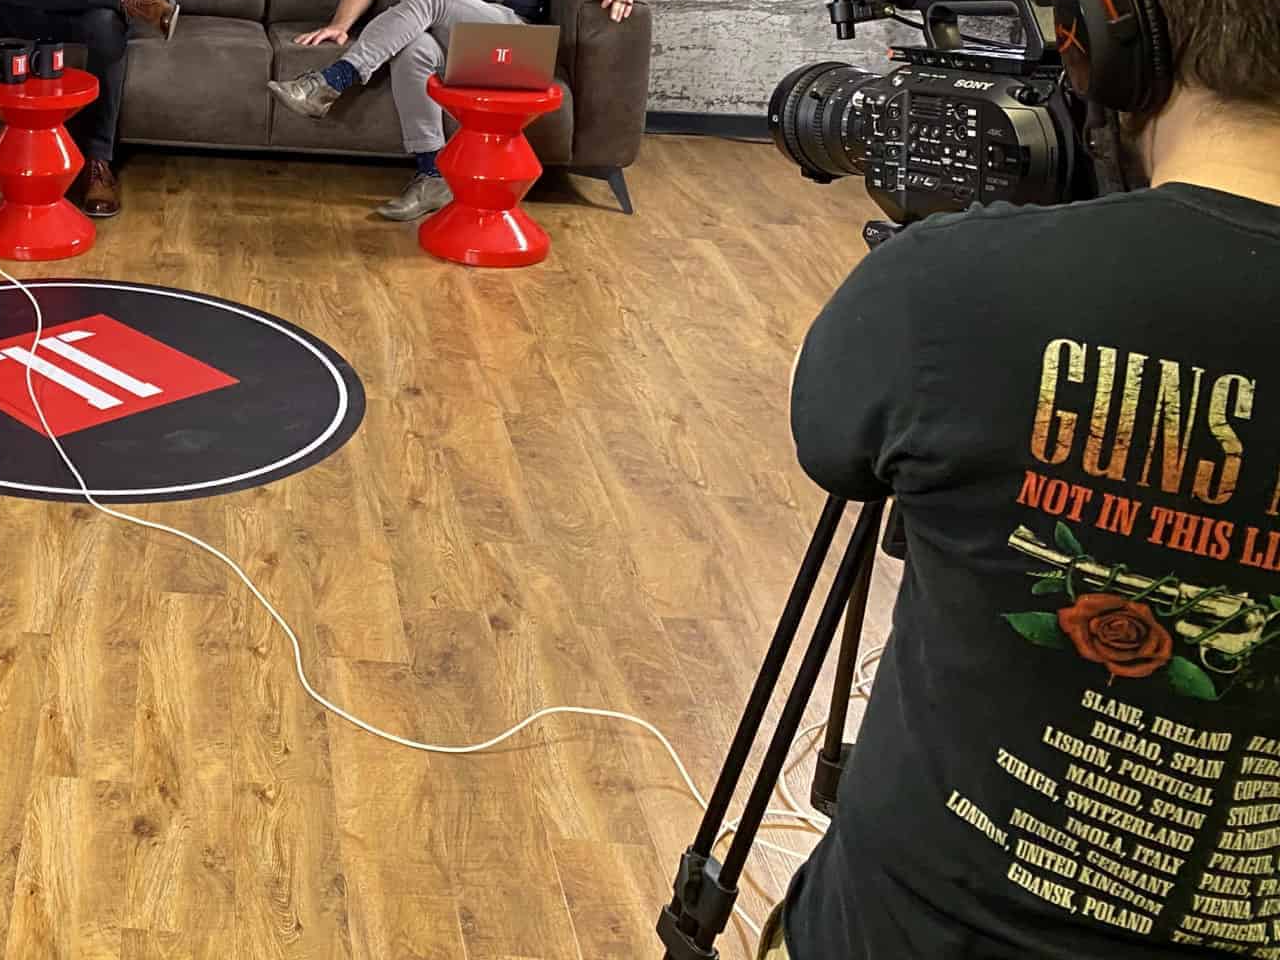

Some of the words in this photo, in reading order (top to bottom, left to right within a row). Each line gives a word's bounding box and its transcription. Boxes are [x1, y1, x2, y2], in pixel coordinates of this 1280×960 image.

[953, 78, 995, 90] SONY
[1029, 337, 1256, 506] GUNS
[1016, 470, 1094, 524] NOT
[1095, 492, 1142, 537] IN
[1147, 505, 1234, 561] THIS
[1081, 690, 1145, 731] SLANE,
[1150, 716, 1232, 752] IRELAND
[1091, 720, 1164, 766] BILBAO,
[1170, 752, 1224, 779] SPAIN
[996, 747, 1060, 802] ZURICH,
[1064, 790, 1194, 852] SWITZERLAND
[1042, 726, 1113, 773] LISBON,
[1117, 759, 1214, 807] PORTUGAL
[1065, 763, 1144, 812] MADRID,
[1149, 798, 1207, 830] SPAIN
[946, 789, 1010, 851] LONDON,
[1015, 838, 1077, 879] UNITED
[1077, 865, 1165, 916] KINGDOM
[1009, 807, 1080, 856] MUNICH,
[1086, 850, 1175, 898] GERMANY
[1065, 816, 1126, 857] IMOLA,
[1132, 844, 1186, 876] ITALY
[1007, 862, 1077, 914] GDANSK,
[1082, 895, 1153, 935] POLAND
[1198, 872, 1251, 898] PARIS,
